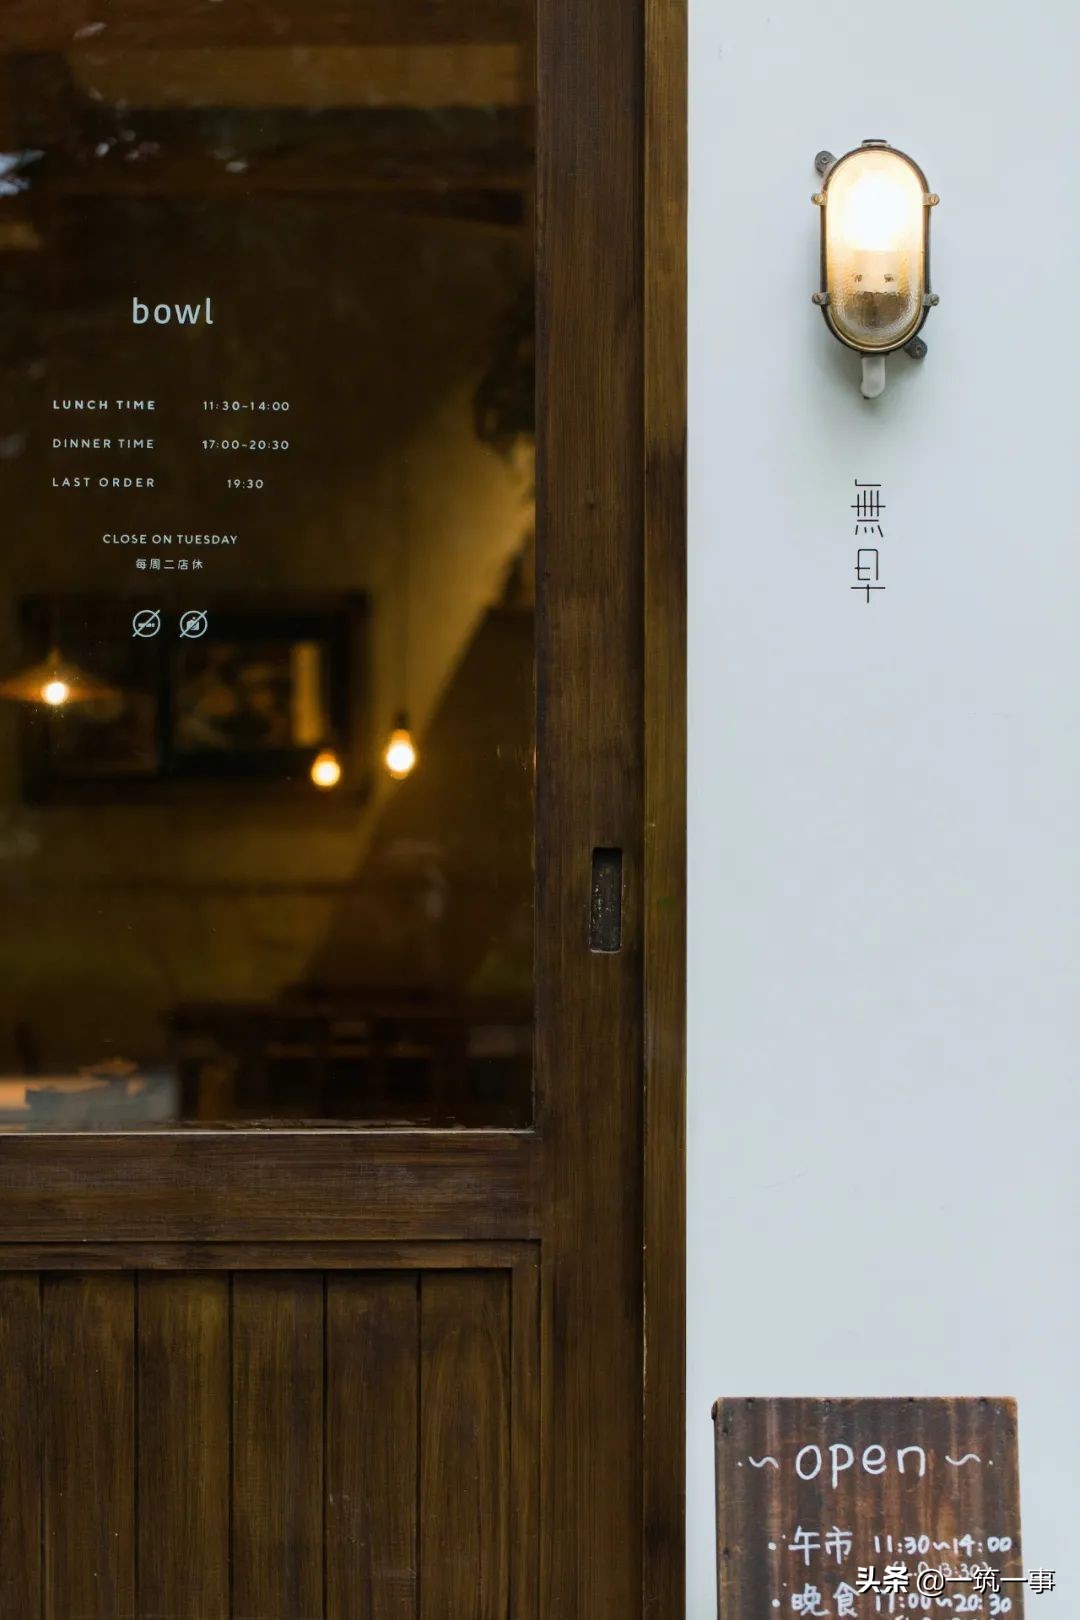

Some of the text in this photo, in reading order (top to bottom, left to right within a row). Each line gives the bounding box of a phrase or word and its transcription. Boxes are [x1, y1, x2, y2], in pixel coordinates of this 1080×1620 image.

[132, 297, 214, 325] bowl
[53, 400, 155, 410] LUNCH TIME
[203, 401, 290, 411] 11:30-14:00
[53, 438, 154, 449] DINNER TIME
[202, 439, 289, 450] 17:00-20:30
[52, 477, 154, 488] LAST ORDER
[227, 479, 264, 489] 19:30
[102, 534, 238, 544] CLOSE ON TUESDAY
[135, 558, 203, 570] 每周二店休
[788, 1525, 853, 1566] 午市
[791, 1582, 860, 1617] 晚食
